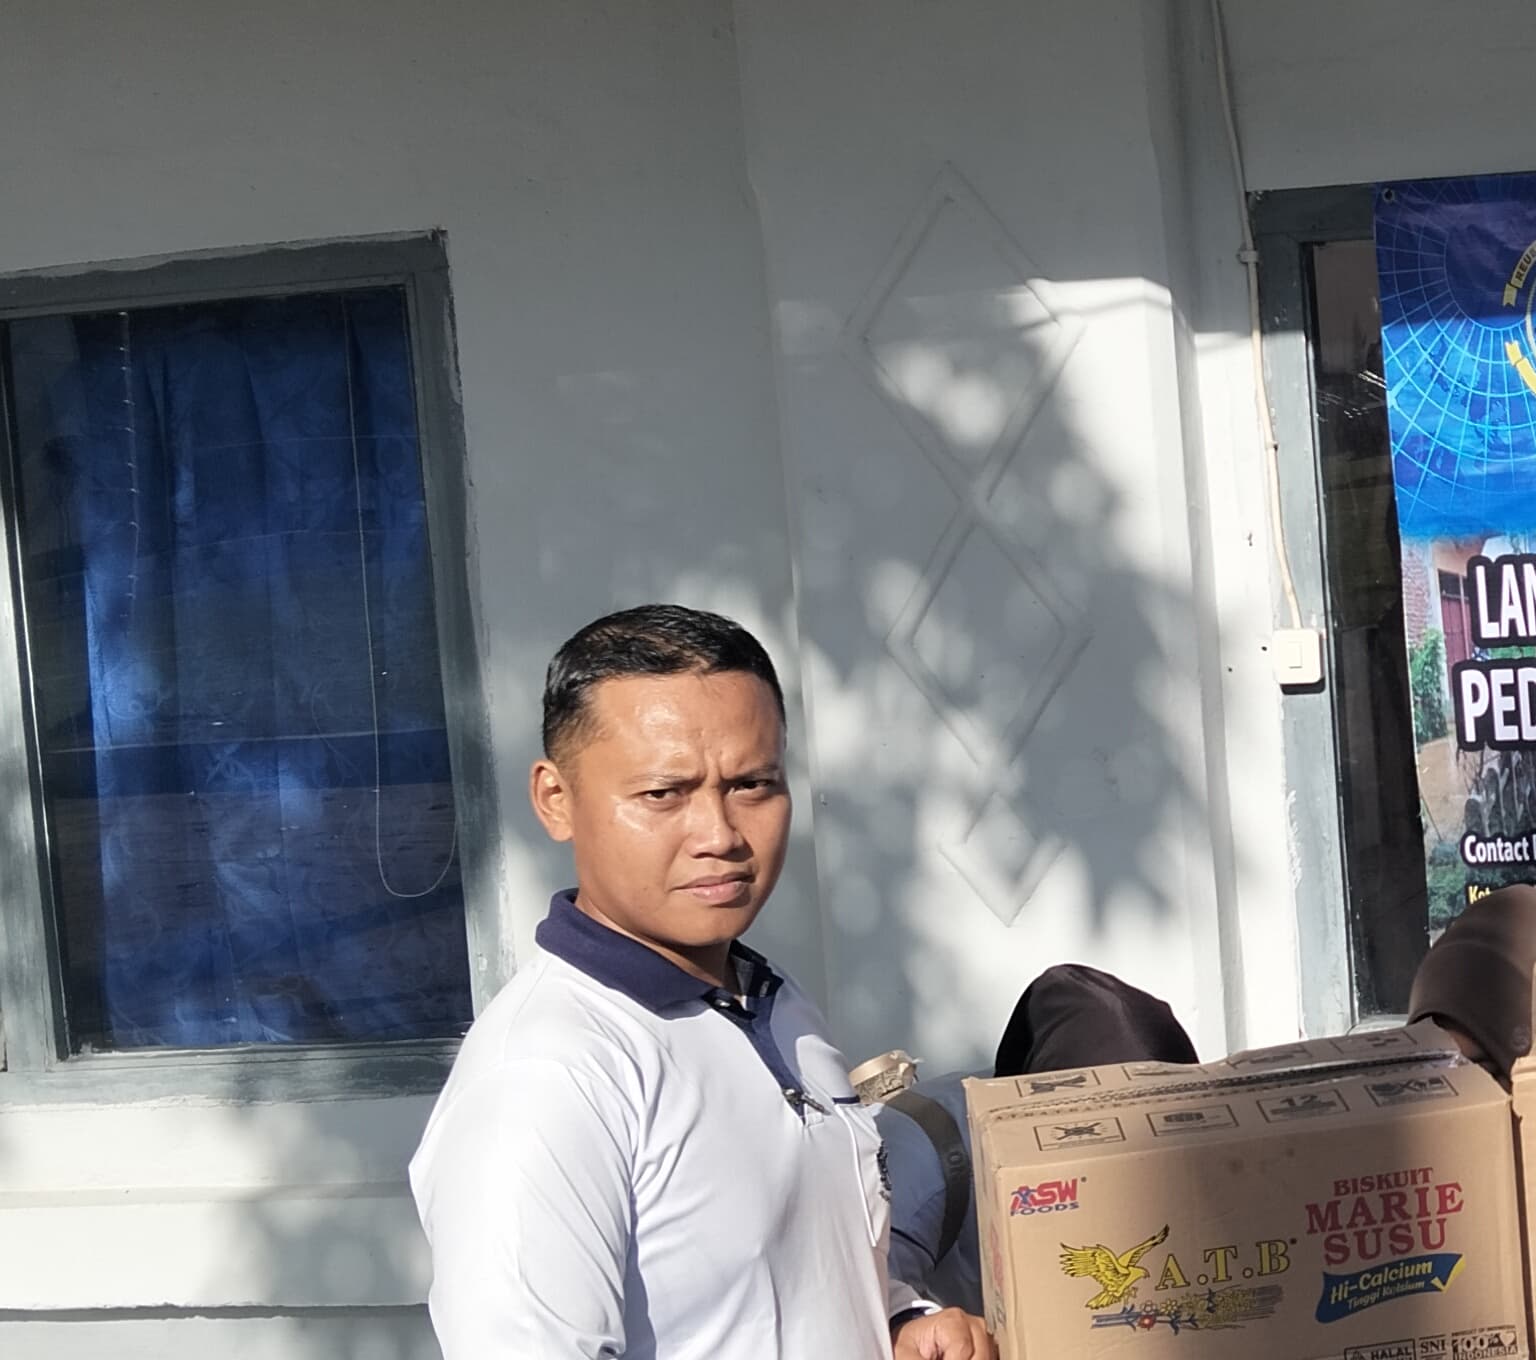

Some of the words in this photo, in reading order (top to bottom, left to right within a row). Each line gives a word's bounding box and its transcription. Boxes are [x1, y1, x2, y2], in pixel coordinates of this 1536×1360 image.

[1464, 835, 1531, 863] Contact
[1333, 1166, 1434, 1197] BISKUIT
[1305, 1181, 1465, 1235] MARIE
[1323, 1217, 1448, 1267] SUSU
[1330, 1259, 1434, 1305] Hi-Calcium
[1347, 1291, 1381, 1310] Tinggi
[1370, 1345, 1413, 1360] HALAL
[1420, 1339, 1447, 1354] SNI
